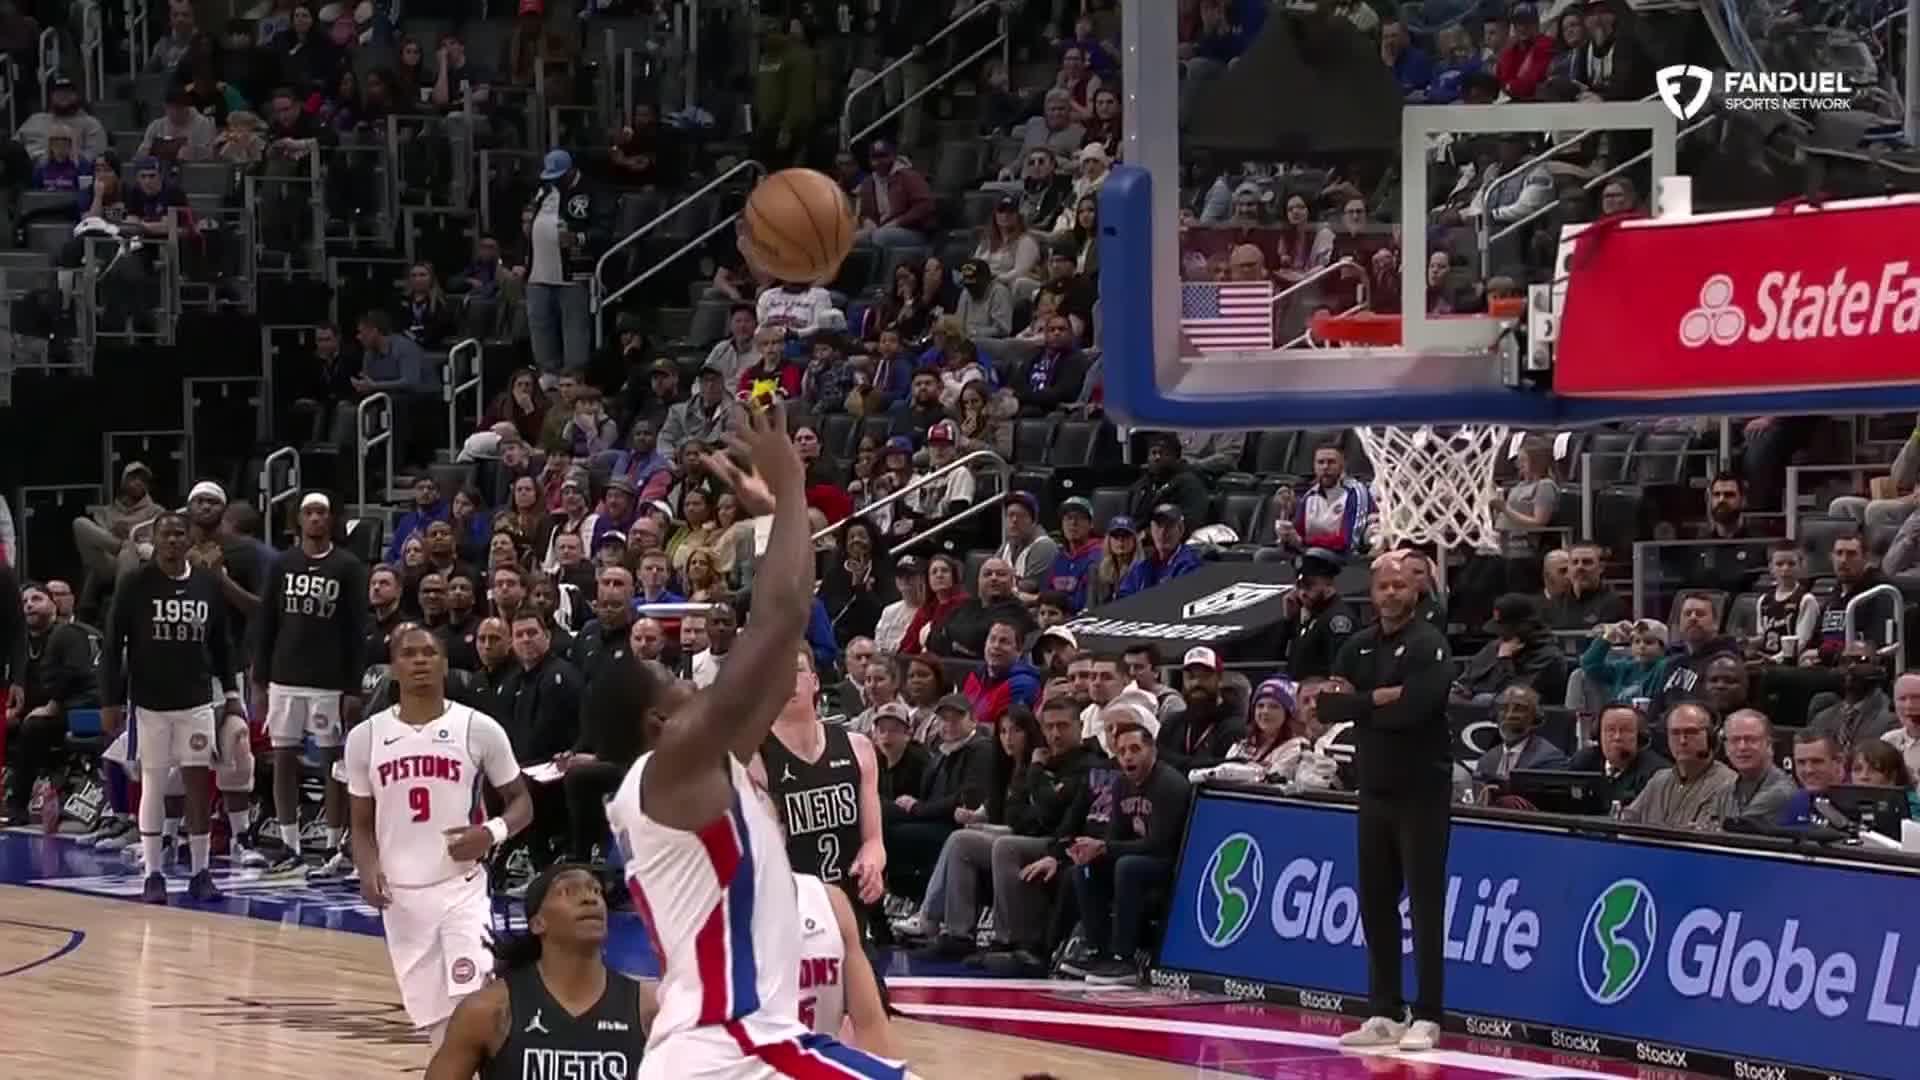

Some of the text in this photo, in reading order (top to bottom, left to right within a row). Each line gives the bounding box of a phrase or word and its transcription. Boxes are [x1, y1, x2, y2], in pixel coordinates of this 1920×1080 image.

[1748, 261, 1920, 343] StateFa
[284, 573, 340, 601] 1950
[152, 600, 209, 625] 1950
[285, 597, 299, 614] 11
[303, 598, 314, 616] 8
[152, 624, 173, 641] 11
[176, 624, 187, 642] 8
[378, 754, 462, 788] PISTONS
[408, 786, 432, 824] 9
[785, 783, 858, 836] NETS
[817, 833, 842, 882] 2
[1271, 857, 1540, 970] Glo Life
[1667, 907, 1857, 1018] Globe
[1150, 969, 1190, 988] StockX
[1224, 979, 1266, 1000] StockX
[1300, 990, 1343, 1012] StockX
[1466, 1016, 1512, 1038] StockX
[1551, 1028, 1600, 1053] StockX
[1636, 1041, 1688, 1068] StockX
[1734, 1060, 1787, 1080] StockX
